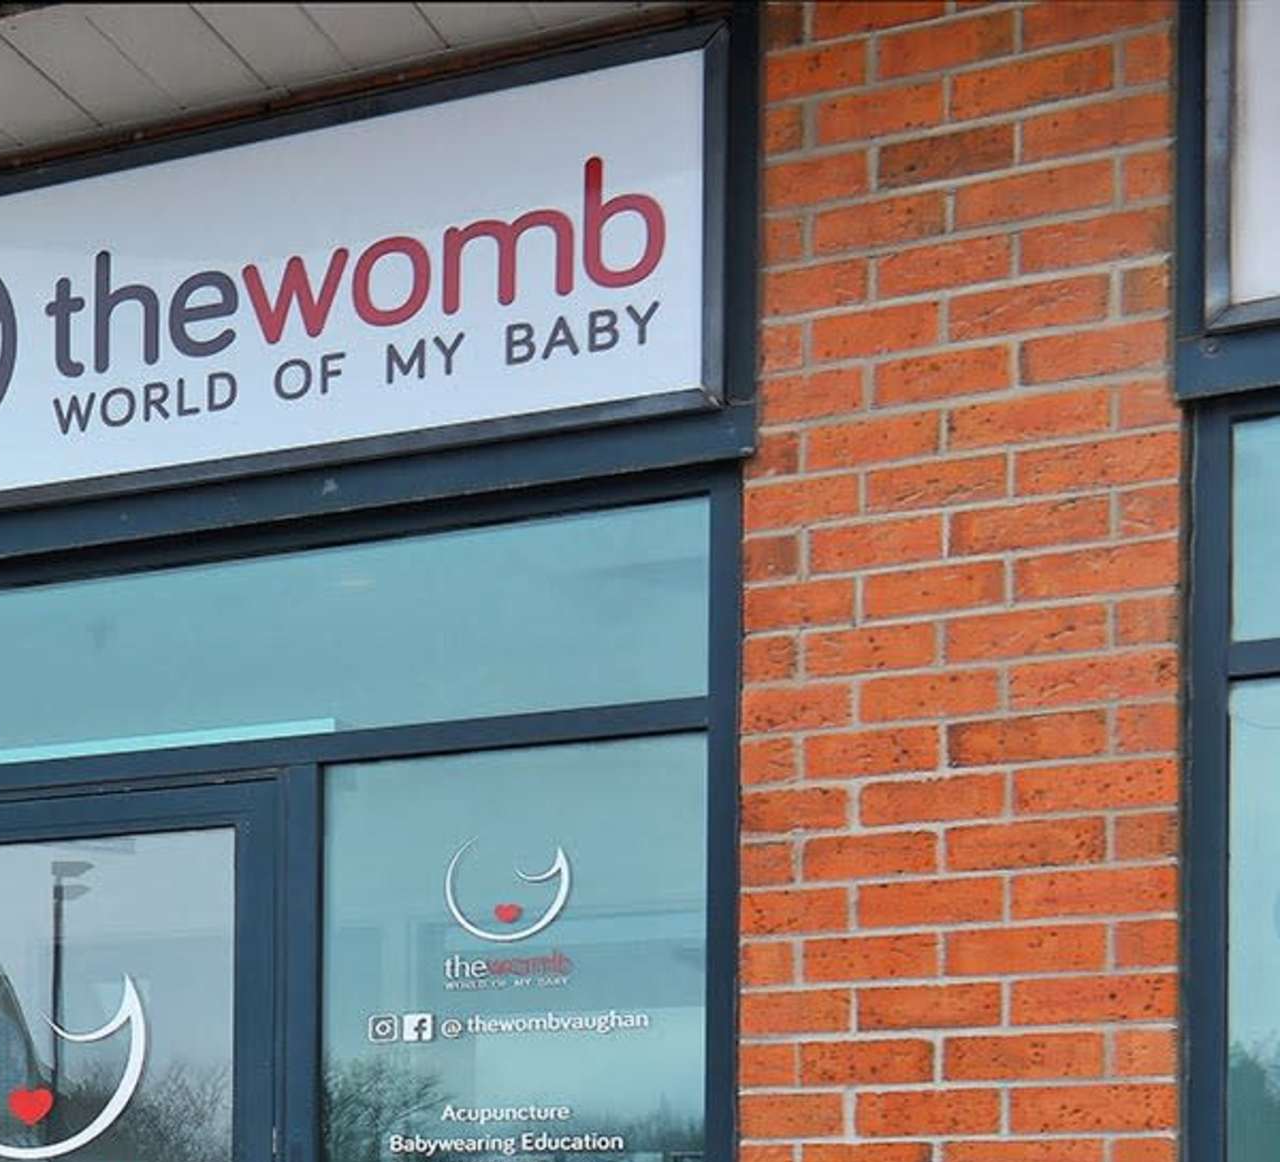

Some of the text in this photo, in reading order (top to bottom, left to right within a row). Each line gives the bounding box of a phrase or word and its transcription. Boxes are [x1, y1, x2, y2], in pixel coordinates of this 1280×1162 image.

[44, 155, 666, 378] thewomb
[52, 300, 662, 436] WORLD OF MY BABY
[468, 1010, 649, 1036] thewombvaughan
[441, 1105, 570, 1124] Acupuncture
[389, 1132, 624, 1156] Babywearing Education
